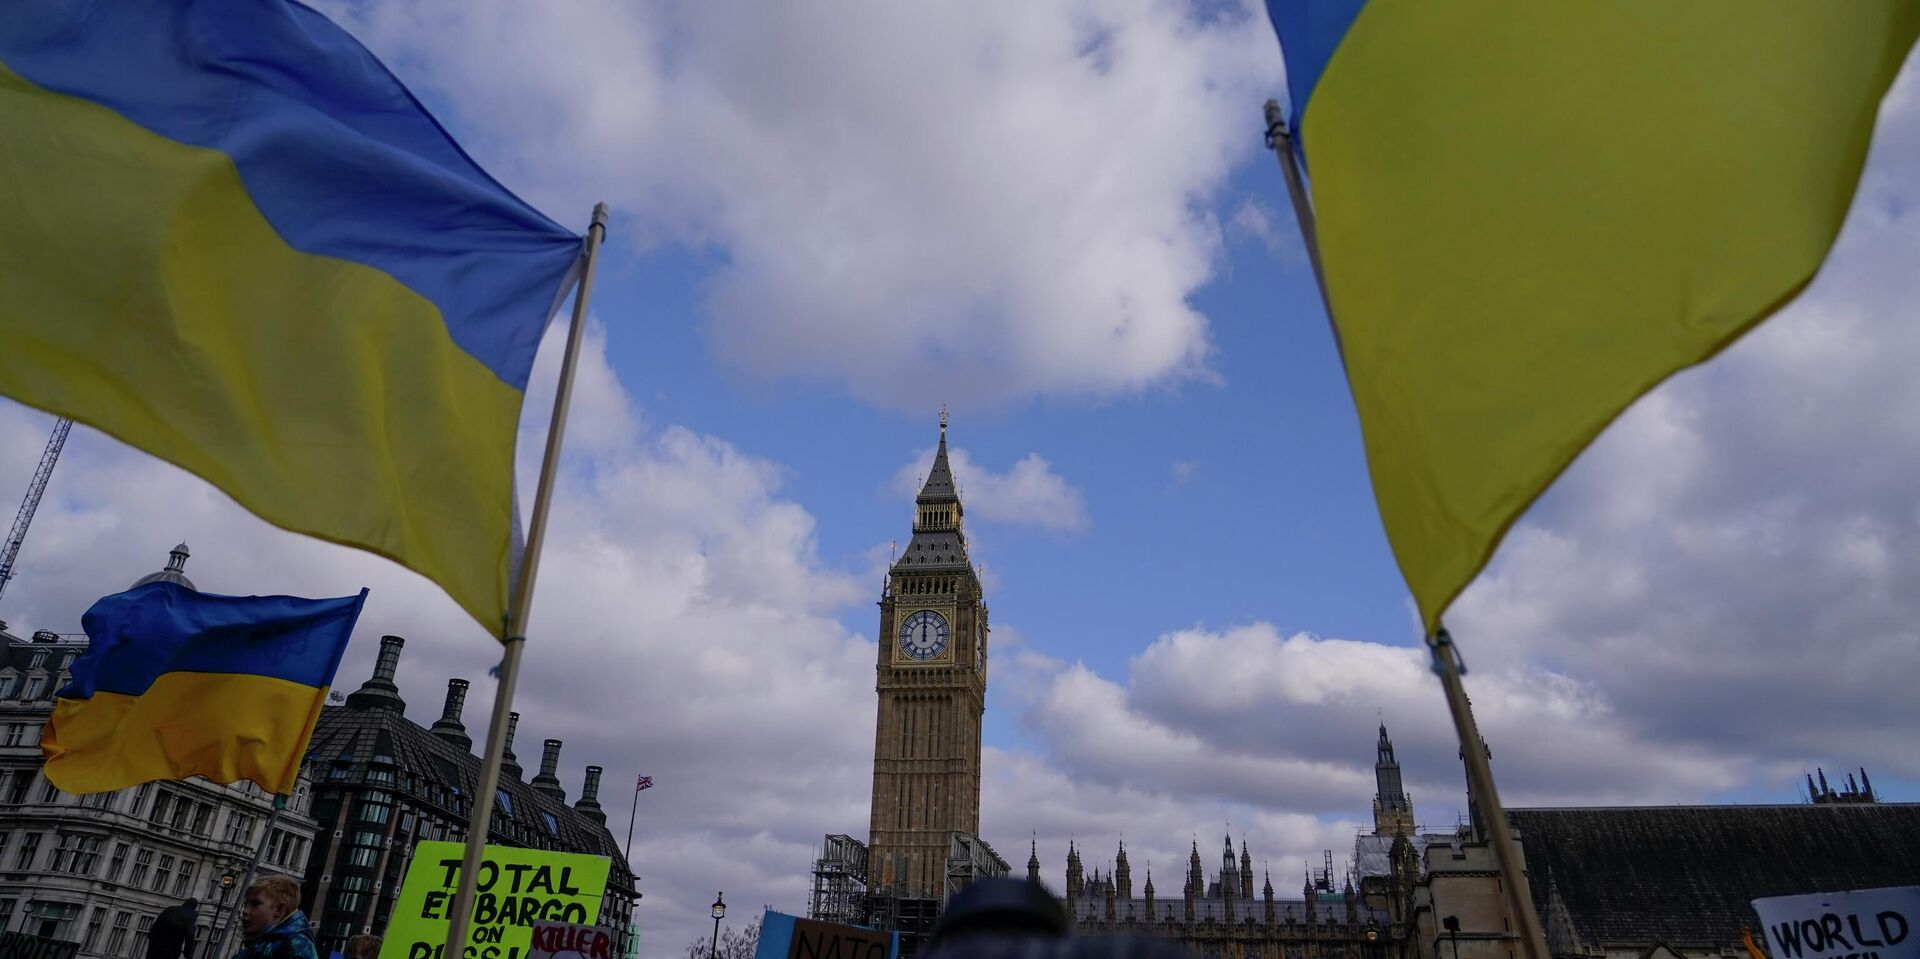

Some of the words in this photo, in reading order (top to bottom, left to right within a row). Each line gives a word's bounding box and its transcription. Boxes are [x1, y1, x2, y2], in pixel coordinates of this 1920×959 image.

[439, 859, 579, 896] TOTAL
[472, 925, 505, 944] ON
[533, 925, 610, 959] KILLER
[795, 930, 886, 959] NATO
[1772, 911, 1909, 959] WORLD
